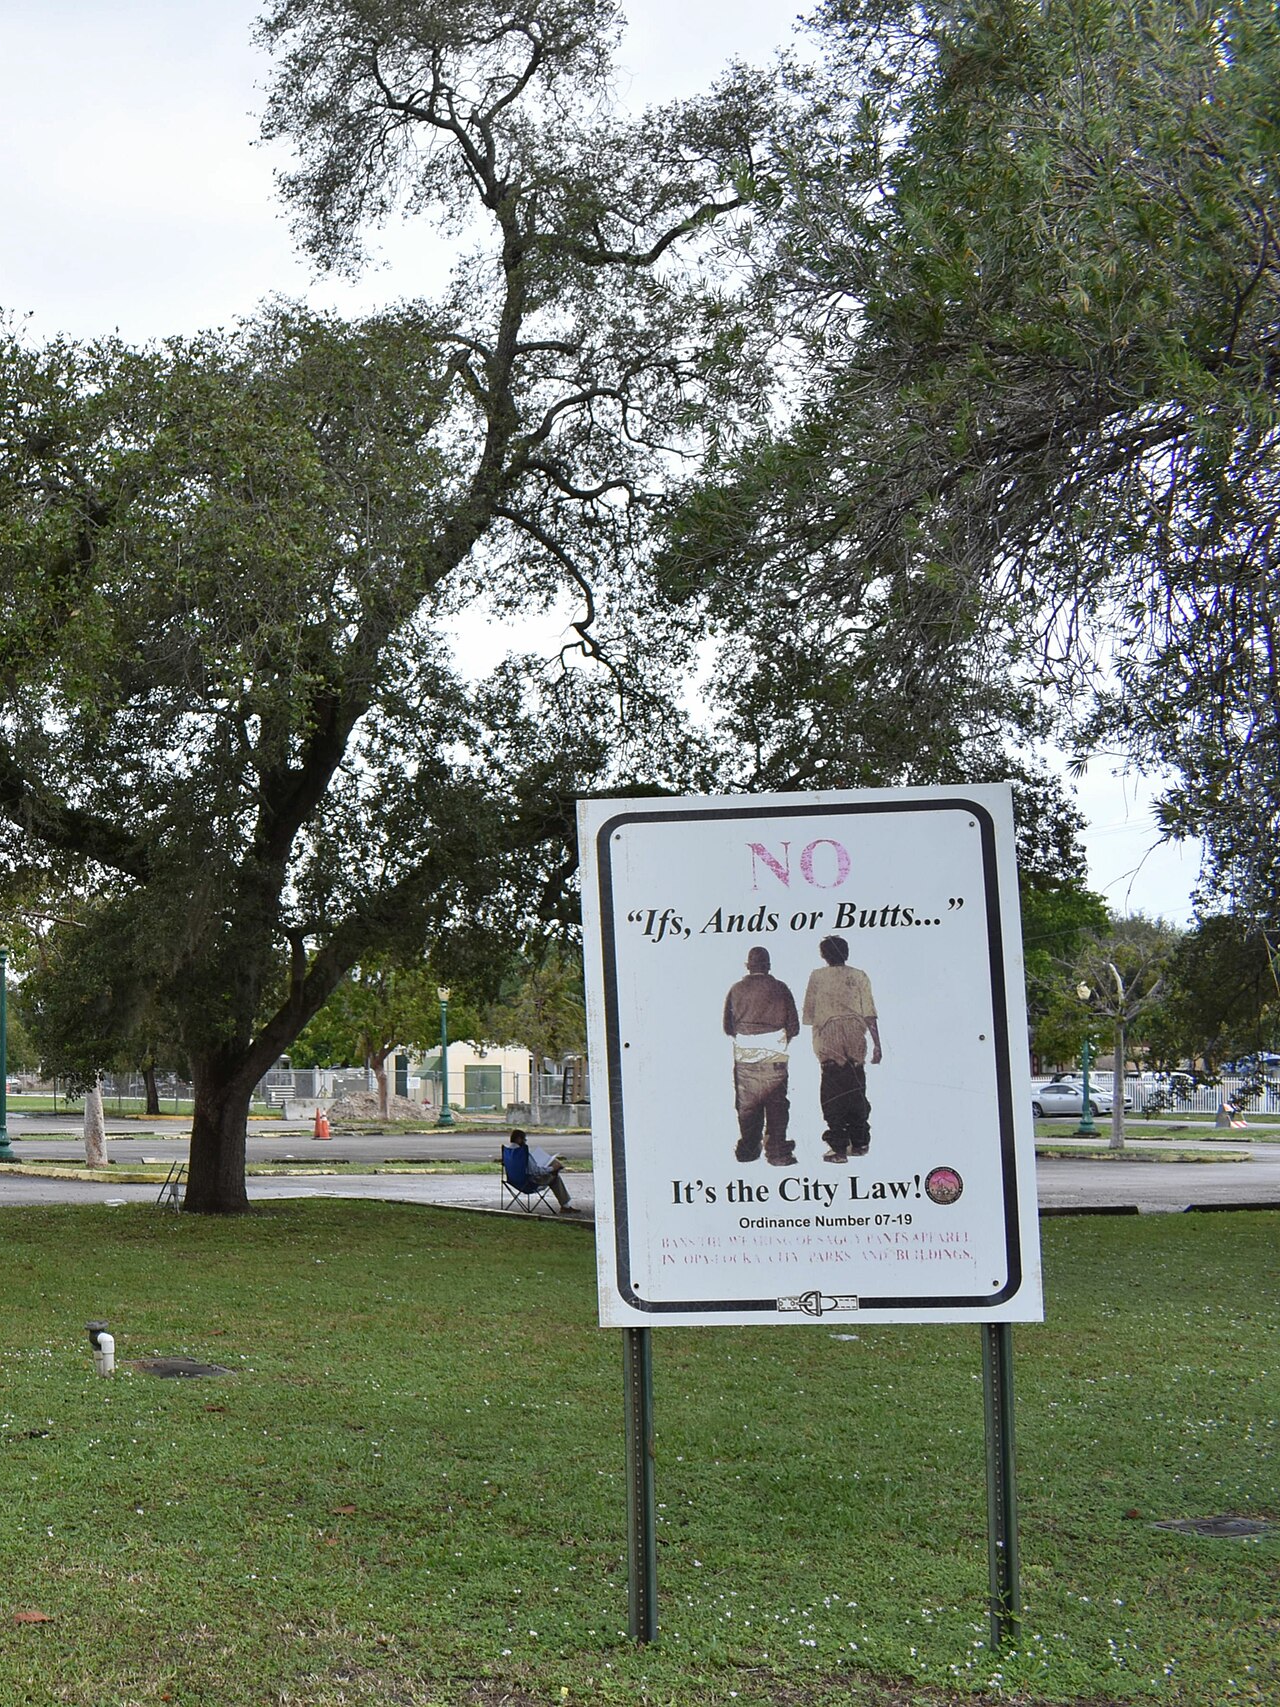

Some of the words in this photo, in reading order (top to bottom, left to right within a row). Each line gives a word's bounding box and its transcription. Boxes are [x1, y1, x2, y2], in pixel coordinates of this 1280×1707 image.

[745, 839, 851, 890] NO
[700, 905, 780, 934] Ands
[790, 910, 823, 931] or
[671, 1179, 717, 1205] It’s
[726, 1177, 770, 1203] the
[778, 1176, 839, 1207] City
[848, 1174, 922, 1200] Law!
[739, 1216, 811, 1229] Ordinance
[815, 1214, 871, 1227] Number
[874, 1213, 913, 1226] 07-19
